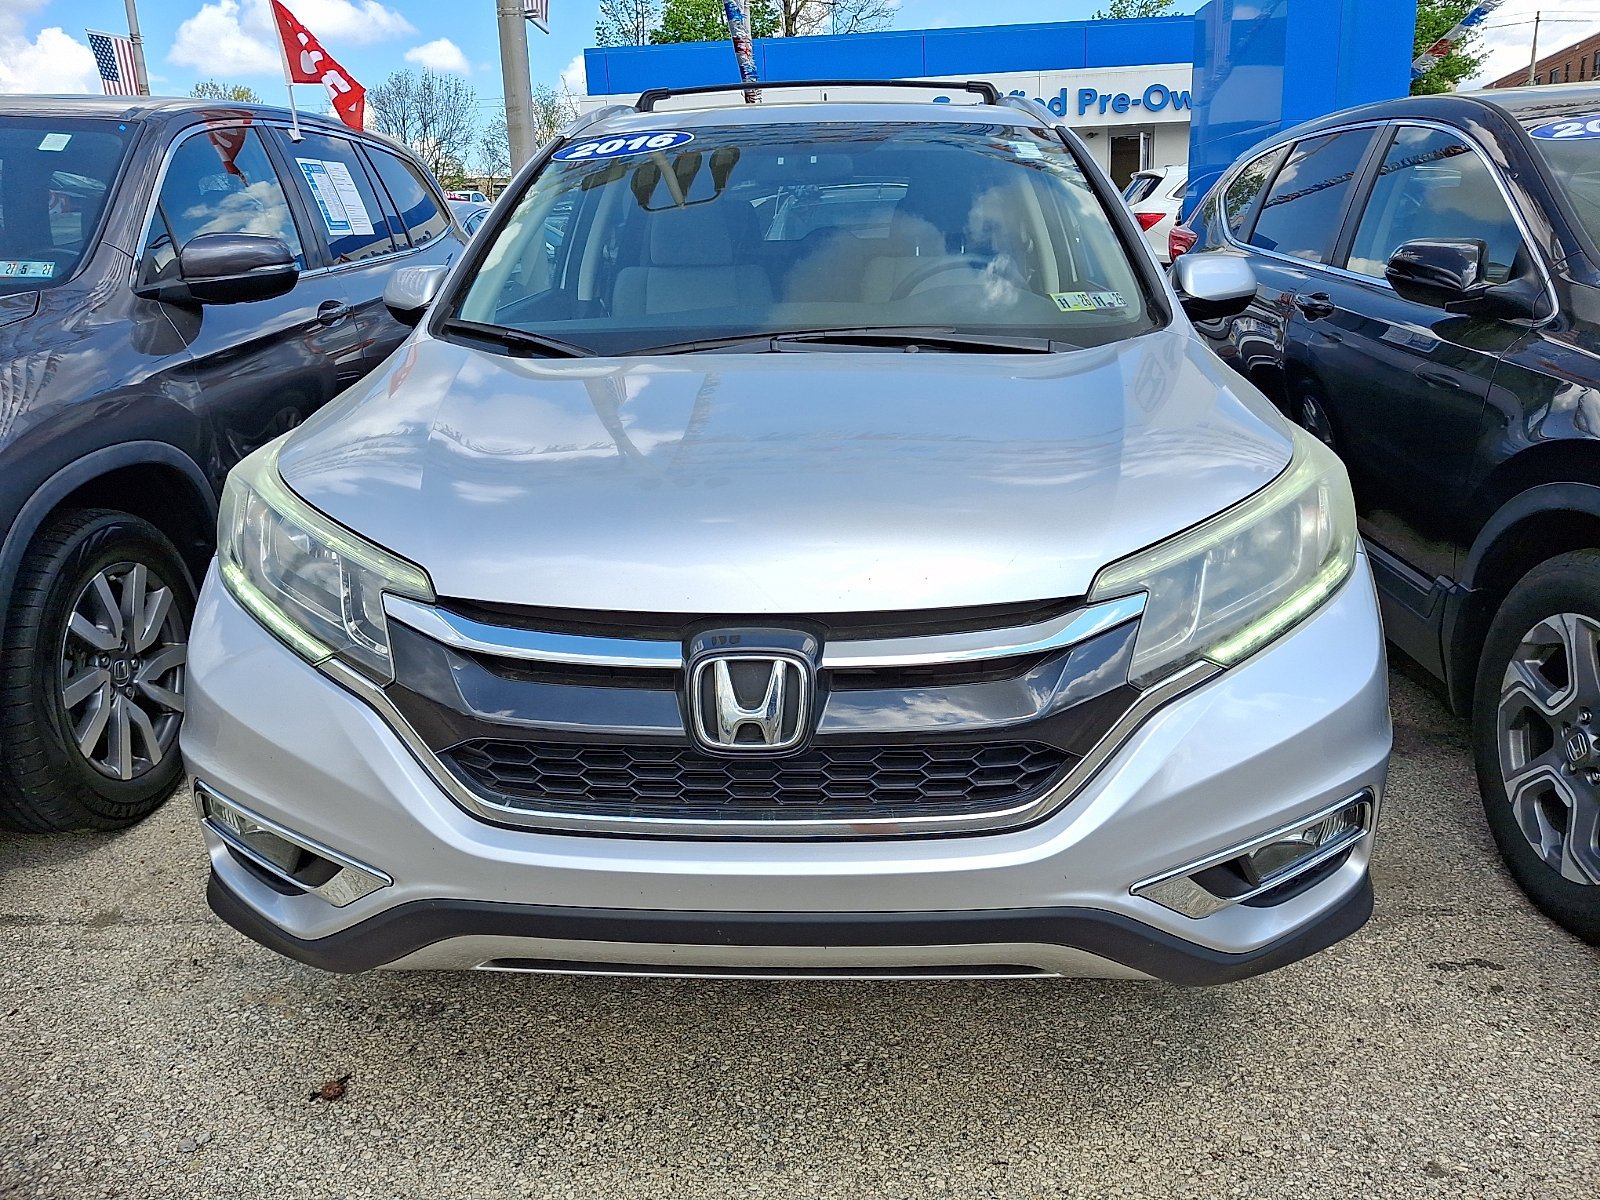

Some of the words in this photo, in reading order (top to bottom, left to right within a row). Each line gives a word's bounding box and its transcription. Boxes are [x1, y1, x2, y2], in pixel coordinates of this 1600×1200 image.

[564, 133, 678, 160] 2016
[5, 263, 16, 275] 27
[42, 264, 52, 276] 27
[1057, 297, 1072, 309] 11
[1093, 296, 1106, 307] 11
